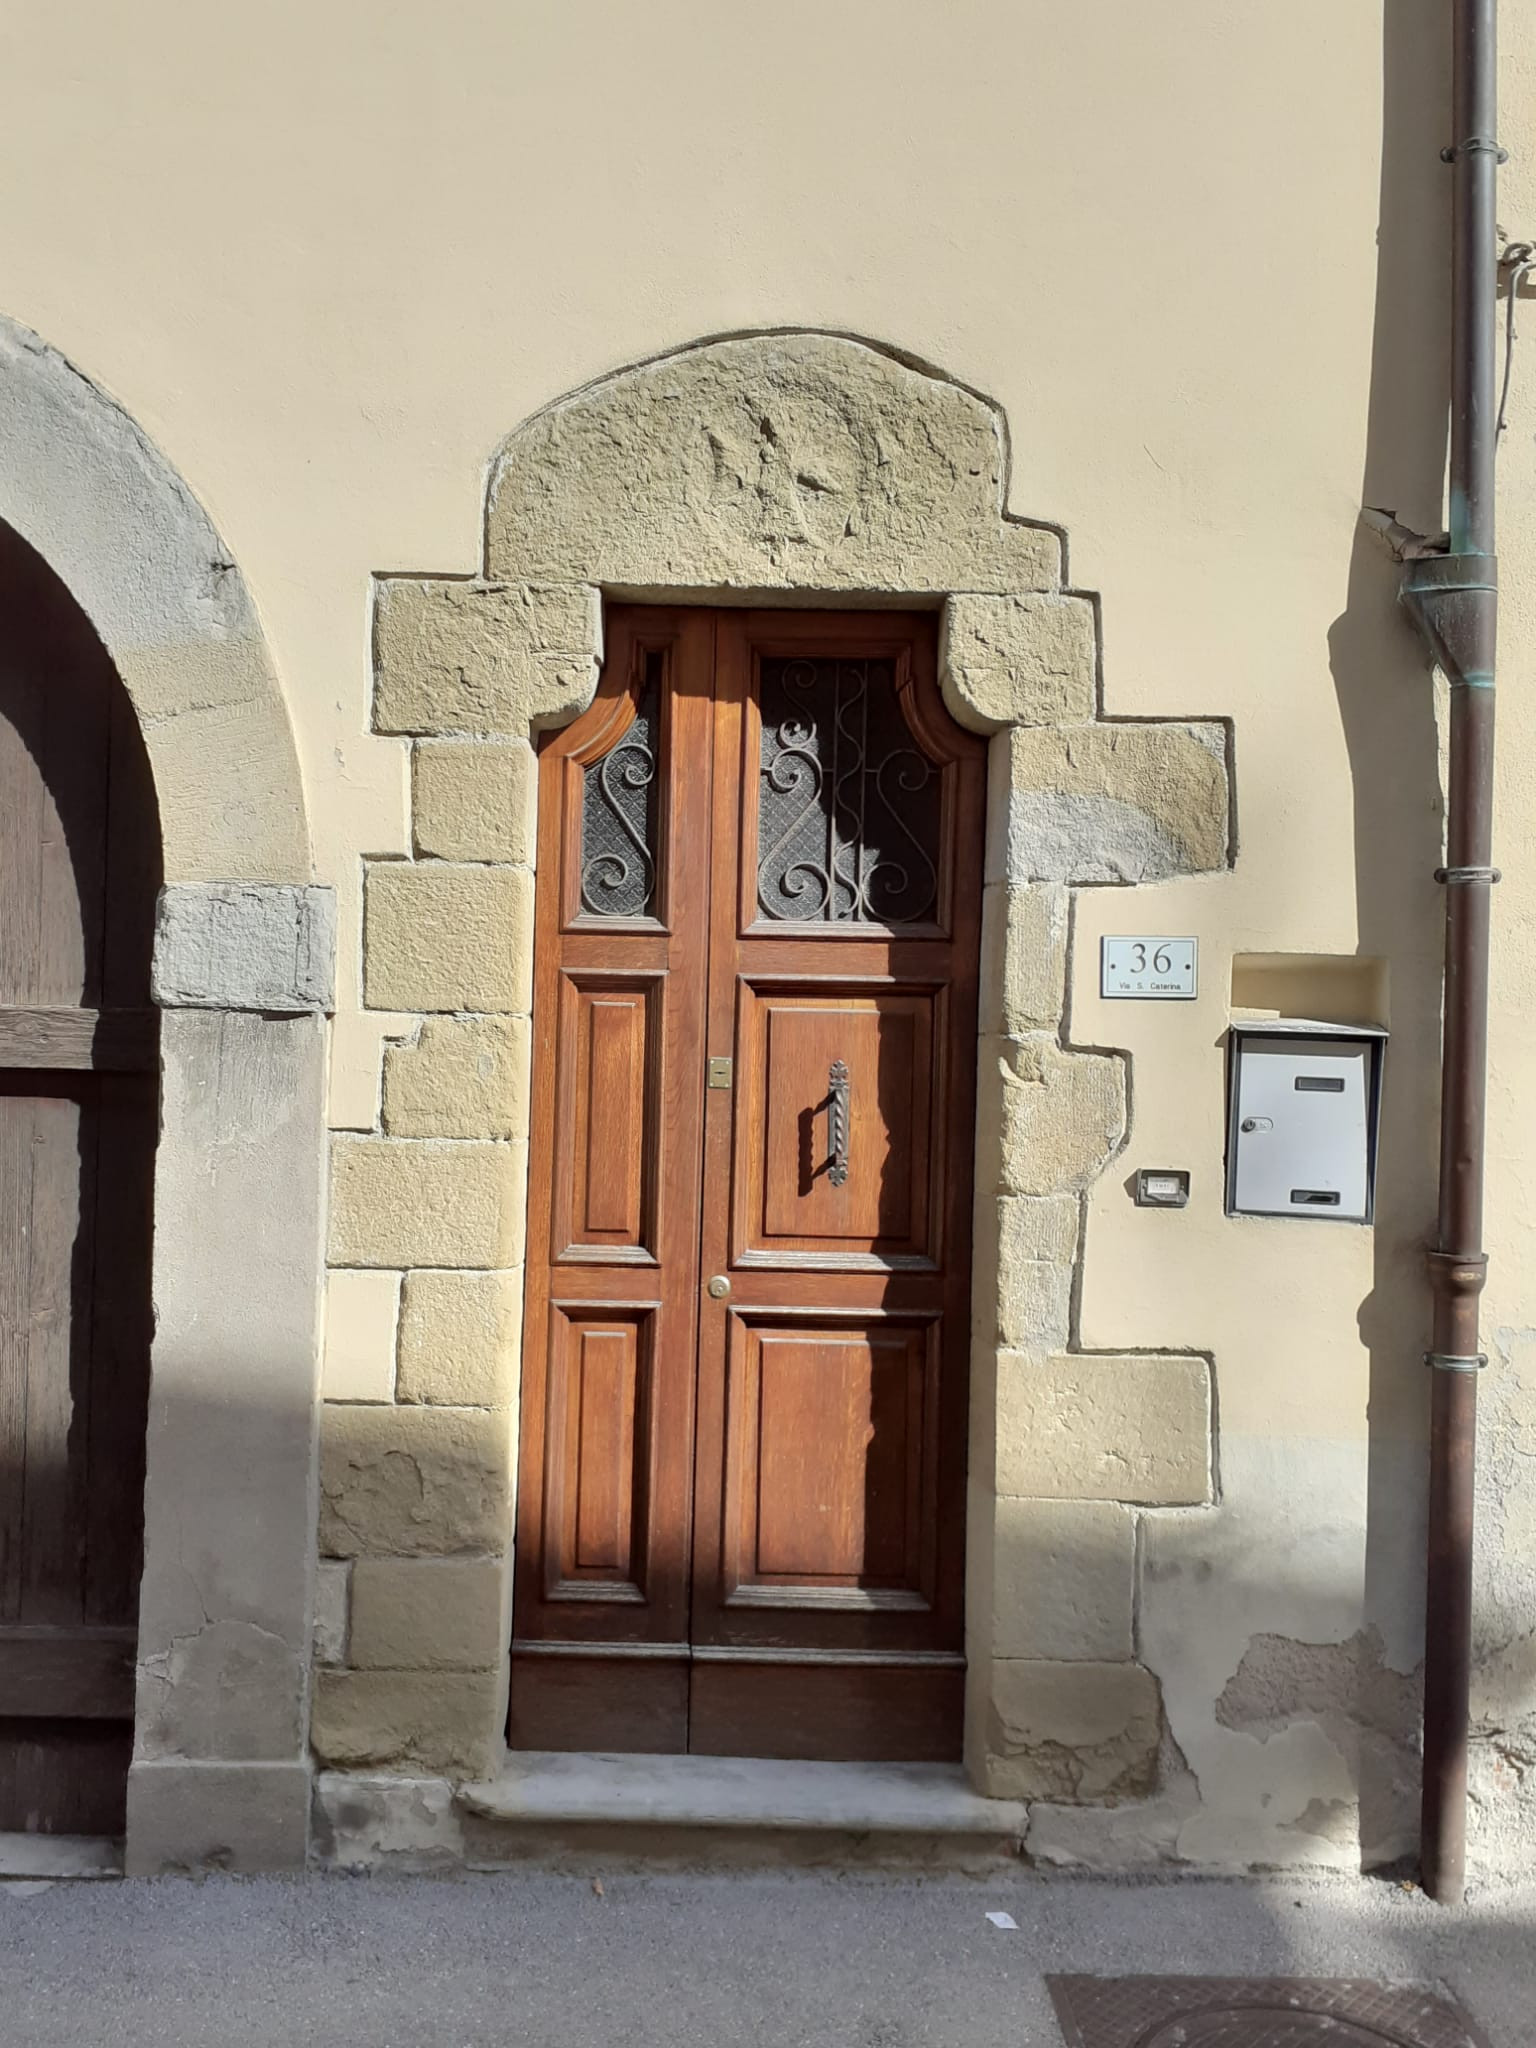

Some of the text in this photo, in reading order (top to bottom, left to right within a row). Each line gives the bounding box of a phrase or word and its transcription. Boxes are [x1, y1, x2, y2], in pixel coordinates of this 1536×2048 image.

[1130, 943, 1172, 974] 36
[1119, 982, 1181, 990] Via S. Caterina
